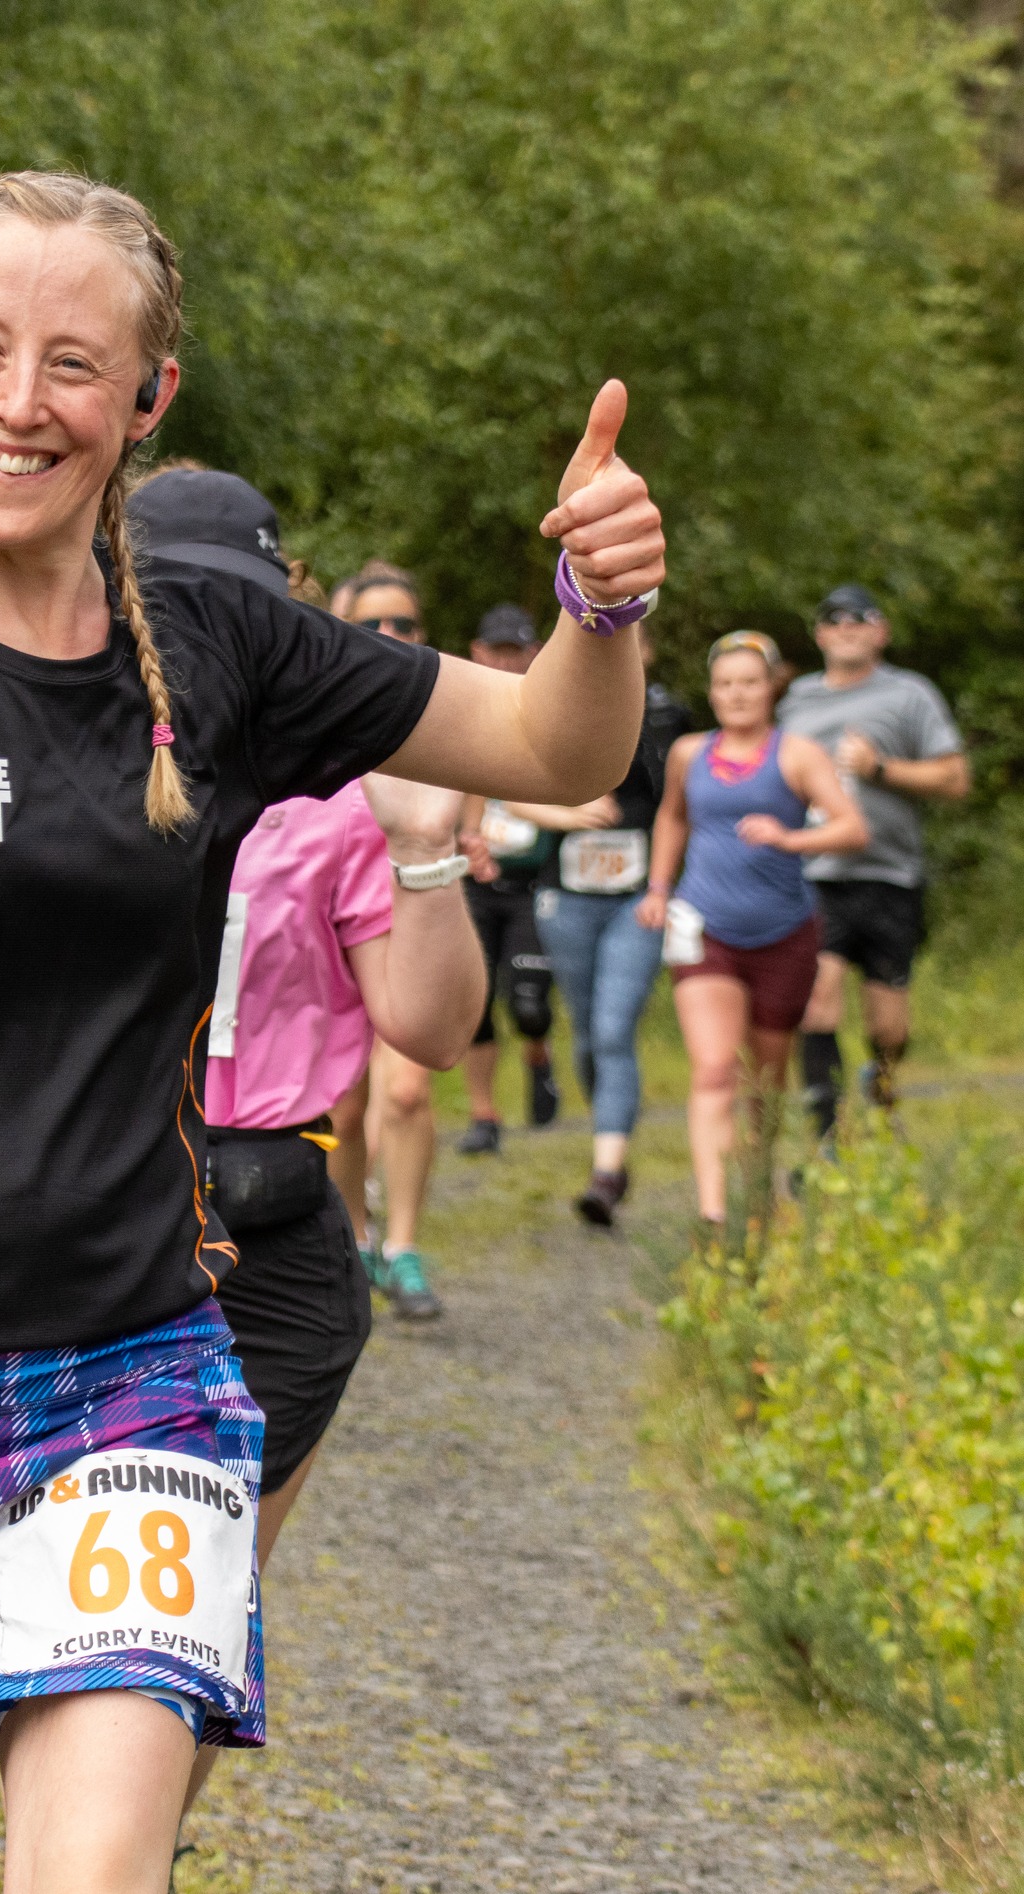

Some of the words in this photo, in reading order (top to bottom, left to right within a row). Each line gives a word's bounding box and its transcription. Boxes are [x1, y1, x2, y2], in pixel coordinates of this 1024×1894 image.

[8, 1486, 46, 1526] UP
[49, 1473, 83, 1505] &
[87, 1464, 244, 1520] RUNNING
[69, 1509, 195, 1617] 68
[52, 1628, 142, 1659] SCURRY
[151, 1630, 221, 1668] EVENTS
